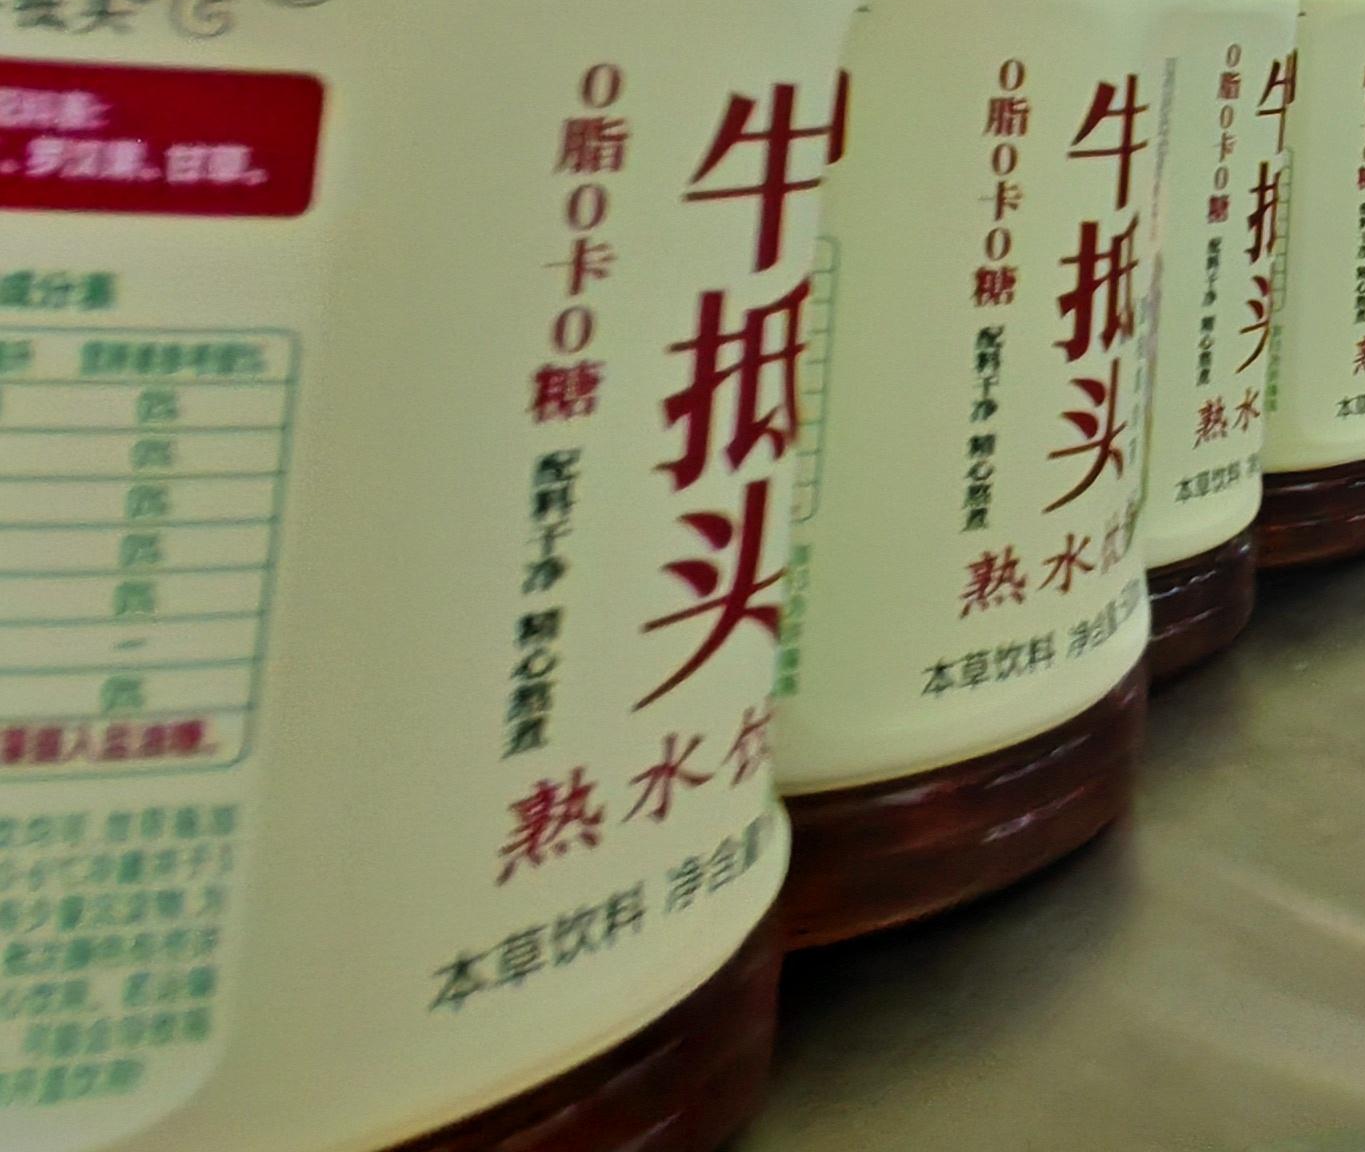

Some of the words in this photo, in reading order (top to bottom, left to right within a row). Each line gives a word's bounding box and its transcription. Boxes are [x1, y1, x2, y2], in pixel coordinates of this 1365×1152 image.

[527, 62, 632, 424] 0脂0卡0糖
[969, 58, 1033, 308] 0脂0卡0糖
[1041, 73, 1150, 515] 牛抵头
[632, 72, 840, 714] 牛抵头
[920, 631, 1058, 698] 本草饮料
[428, 880, 648, 1015] 本草饮料
